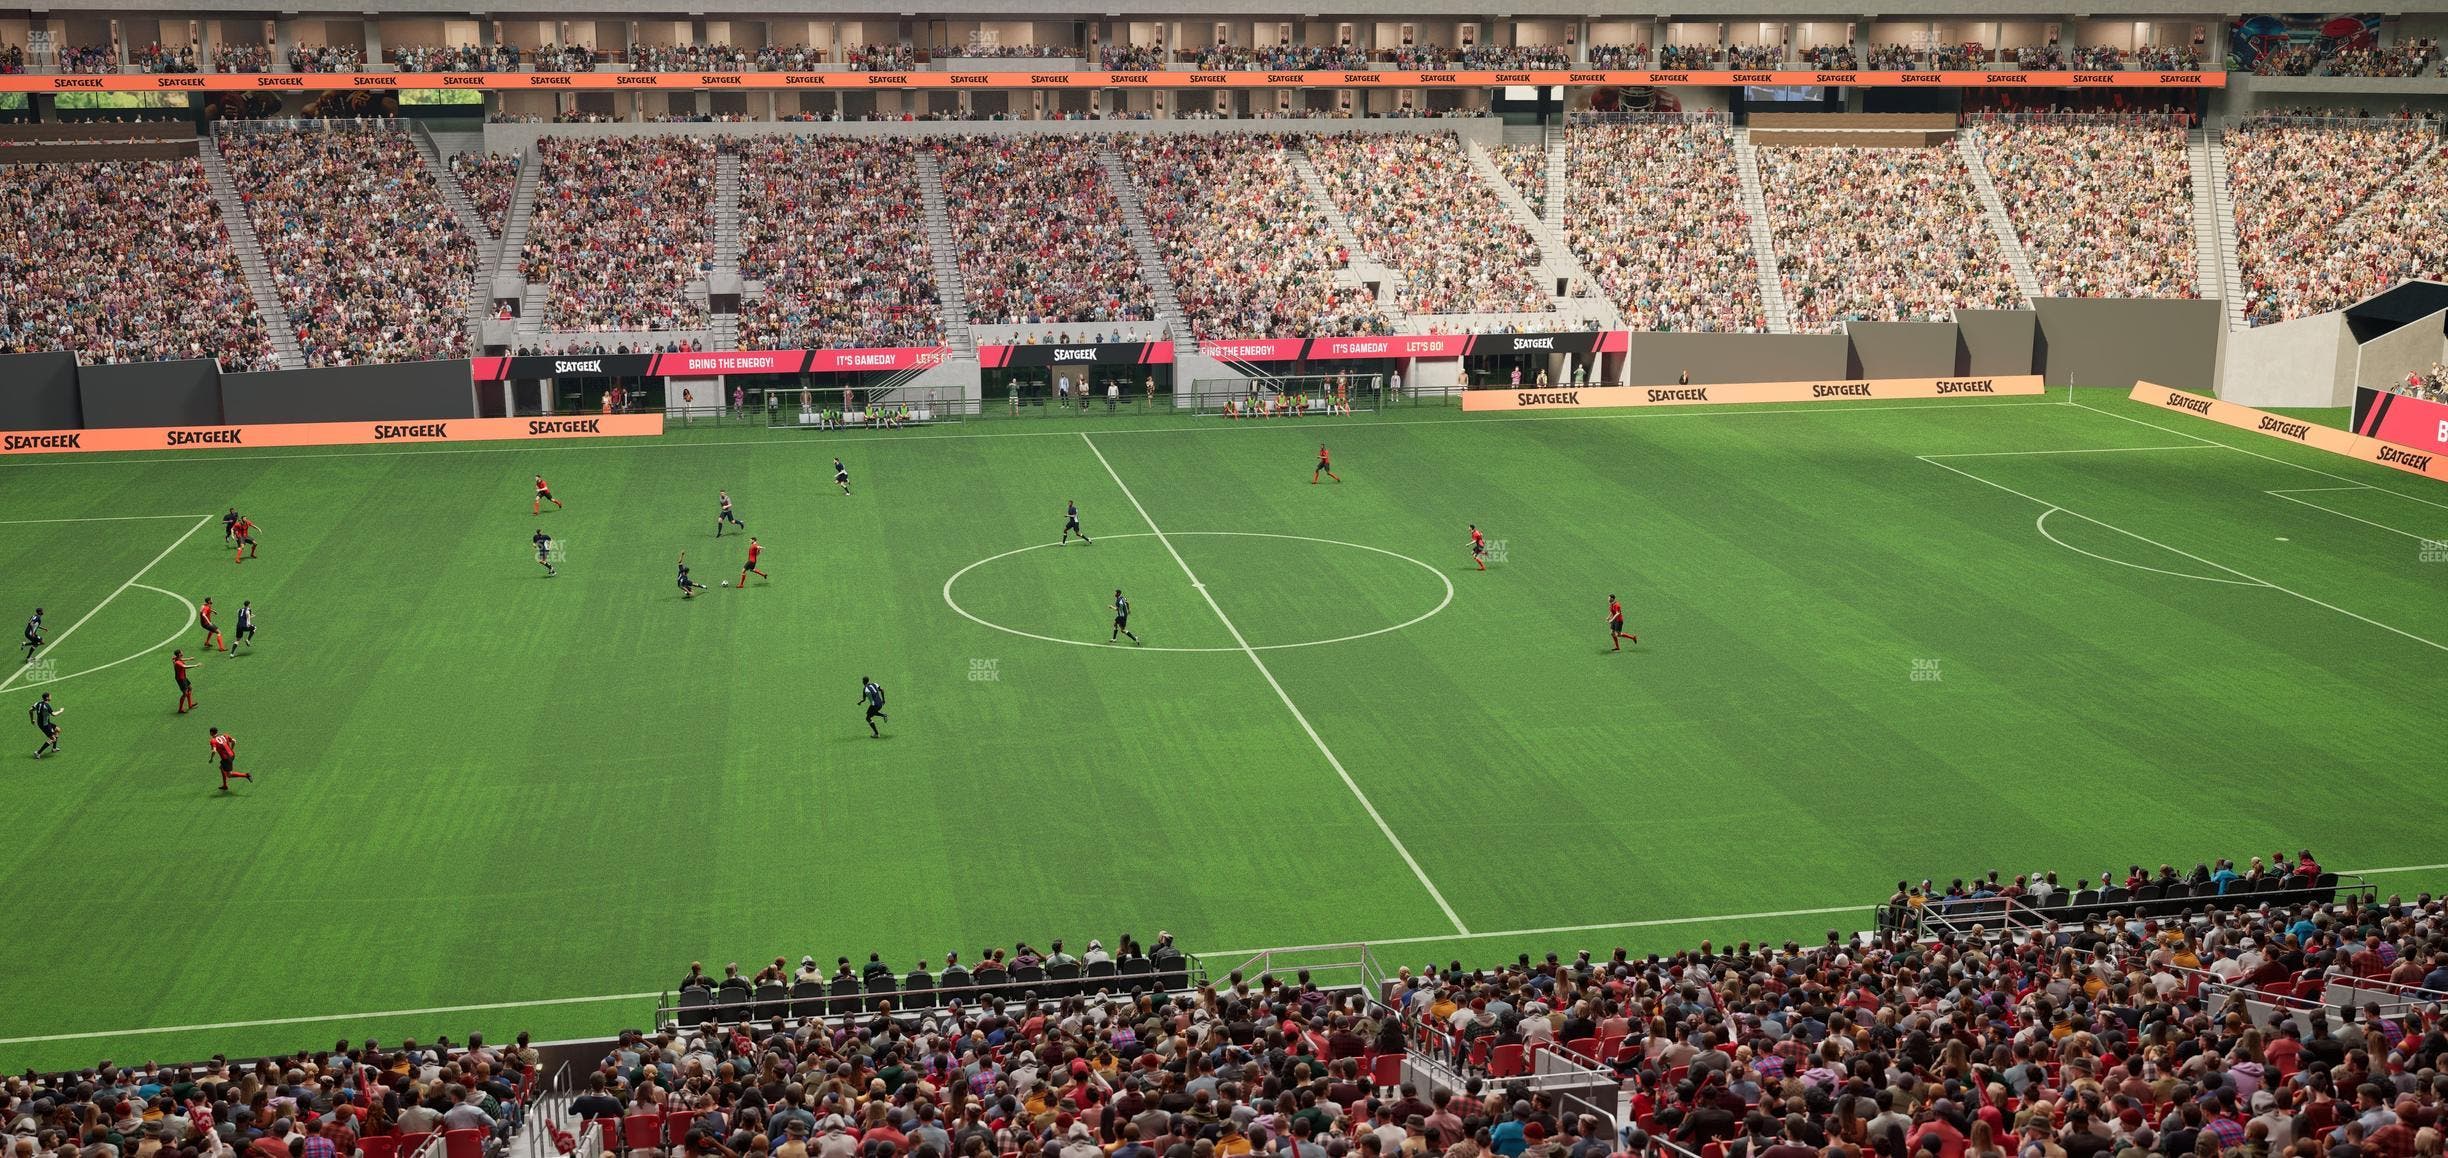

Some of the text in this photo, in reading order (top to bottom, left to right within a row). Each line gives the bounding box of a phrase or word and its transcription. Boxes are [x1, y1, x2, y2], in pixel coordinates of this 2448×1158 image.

[159, 78, 205, 87] SEATGEEK
[258, 78, 303, 87] SEATGEEK
[354, 77, 396, 86] SEATGEEK
[444, 77, 484, 85] SEATGEEK
[531, 77, 571, 85] SEATGEEK
[617, 76, 656, 84] SEATGEEK
[702, 76, 741, 84] SEATGEEK
[786, 76, 824, 84] SEATGEEK
[869, 76, 906, 84] SEATGEEK
[1112, 75, 1147, 83] SEATGEEK
[1496, 74, 1530, 82] SEATGEEK
[1570, 74, 1605, 82] SEATGEEK
[1650, 74, 1688, 82] SEATGEEK
[1733, 74, 1771, 82] SEATGEEK
[1817, 74, 1855, 82] SEATGEEK
[1901, 74, 1941, 82] SEATGEEK
[1987, 74, 2027, 82] SEATGEEK
[2073, 74, 2113, 83] SEATGEEK
[2160, 75, 2201, 83] SEATGEEK
[55, 79, 103, 88] SEATGEEK
[1332, 342, 1388, 353] IT'S GAMEDAY
[1407, 341, 1444, 352] LET'S GO!
[1514, 336, 1554, 350] SEATGEEK
[1054, 347, 1097, 361] SEATGEEK
[1224, 346, 1238, 356] THE
[1240, 345, 1275, 356] ENERGY!
[689, 356, 774, 370] BRING THE ENERGY!
[836, 354, 896, 366] IT'S GAMEDAY
[555, 359, 602, 374] SEATGEEK
[1812, 383, 1871, 398] SEATGEEK
[1937, 380, 1994, 394] SEATGEEK
[1518, 392, 1579, 407] SEATGEEK
[1647, 388, 1708, 402] SEATGEEK
[2167, 393, 2212, 415] SEATGEEK
[530, 419, 600, 435] SEATGEEK
[2259, 416, 2310, 440] SEATGEEK
[375, 424, 447, 440] SEATGEEK
[4, 434, 81, 450] SEATGEEK
[168, 430, 242, 446] SEATGEEK
[2377, 446, 2432, 472] SEATGEEK
